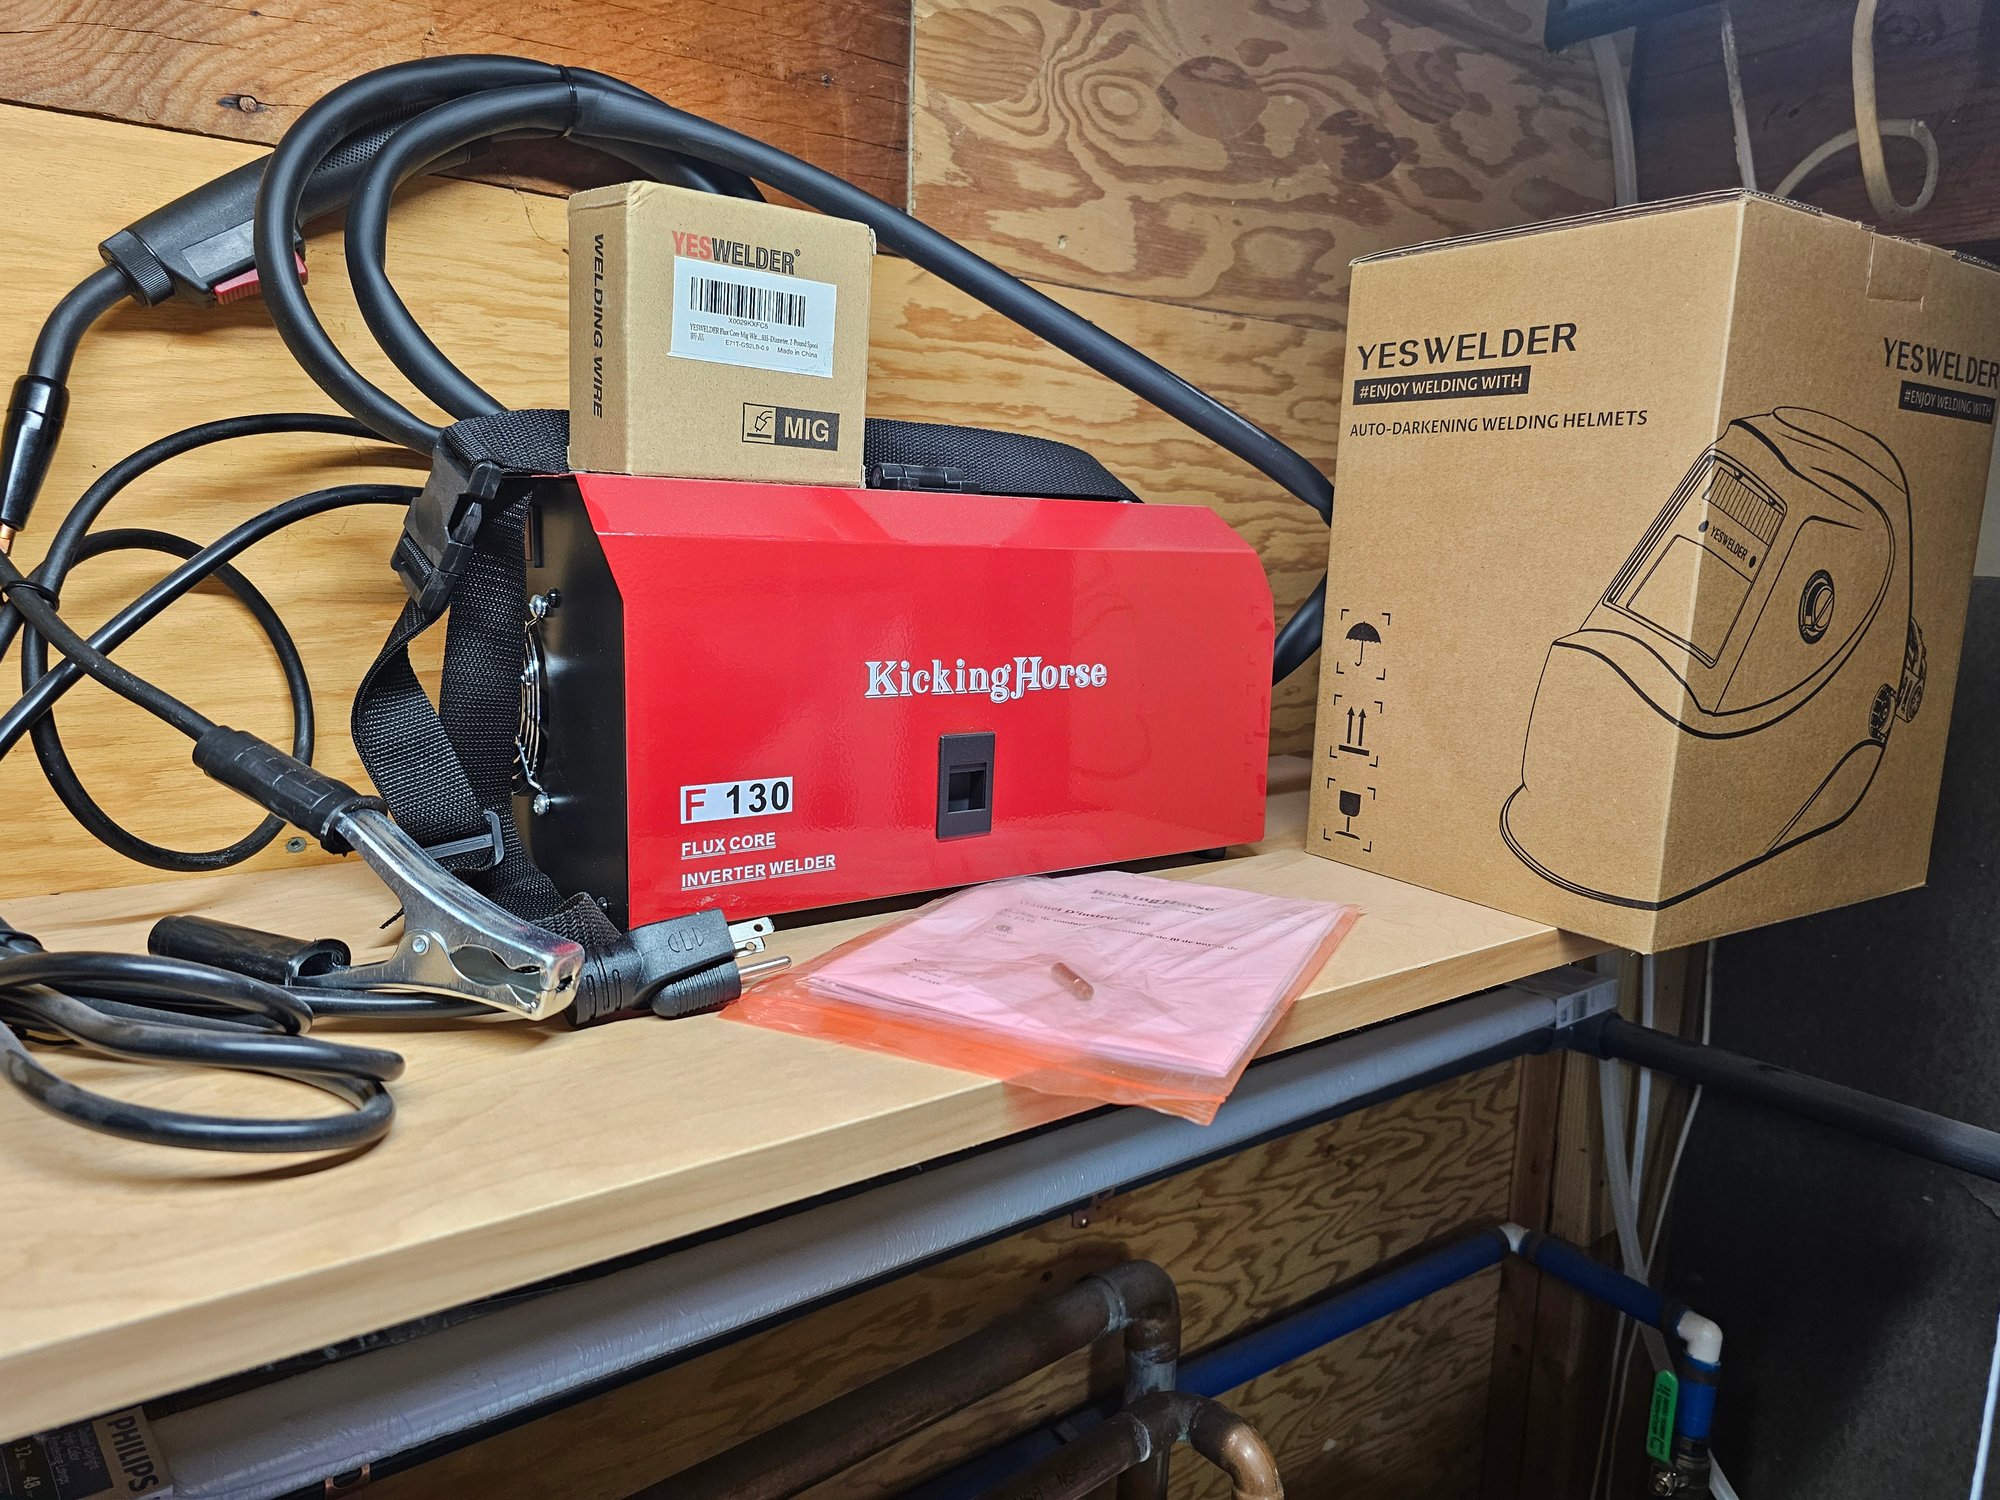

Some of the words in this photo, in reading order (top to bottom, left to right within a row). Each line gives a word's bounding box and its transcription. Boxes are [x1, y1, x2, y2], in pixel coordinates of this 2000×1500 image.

[593, 233, 604, 348] WELDING
[690, 323, 720, 334] YESWELDER
[777, 347, 793, 355] Made
[801, 350, 818, 358] China
[1357, 322, 1577, 370] YESWELDER
[1883, 337, 2000, 389] YESWELDER
[593, 357, 603, 418] WIRE
[1359, 380, 1410, 399] #ENJOY
[1412, 376, 1478, 395] WELDING
[1481, 373, 1523, 390] WITH
[1904, 388, 1937, 408] #ENJOY
[1937, 395, 1972, 414] WELDING
[1972, 402, 1992, 417] WITH
[784, 416, 830, 443] MIG
[1350, 417, 1478, 437] AUTO-DARKENING
[1482, 414, 1559, 432] WELDING
[1563, 410, 1648, 429] HELMETS
[1711, 526, 1748, 561] YESWELDER
[864, 656, 1108, 704] KickingHorse
[685, 788, 706, 822] F
[726, 781, 791, 815] 130
[681, 837, 726, 858] FLUX
[729, 832, 776, 853] CORE
[681, 863, 766, 889] INVERTER
[769, 854, 836, 877] WELDER
[14, 1444, 33, 1458] 32
[107, 1415, 159, 1492] PHILIPS
[23, 1476, 42, 1490] 48
